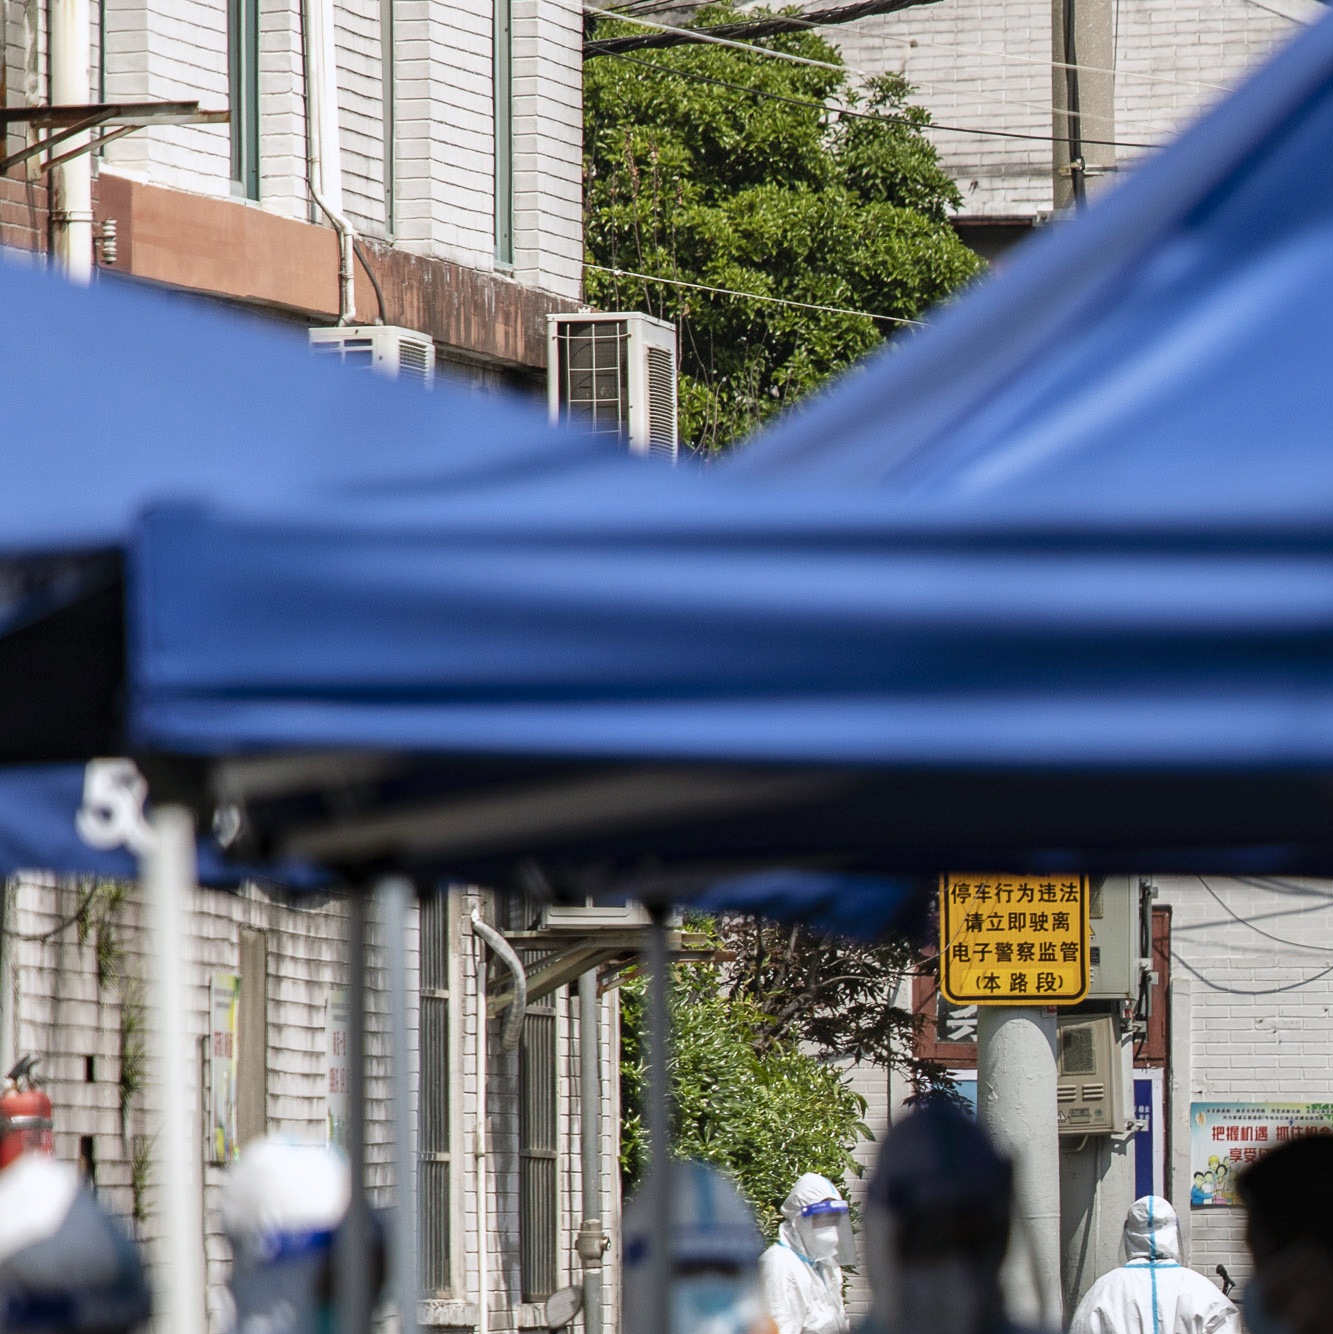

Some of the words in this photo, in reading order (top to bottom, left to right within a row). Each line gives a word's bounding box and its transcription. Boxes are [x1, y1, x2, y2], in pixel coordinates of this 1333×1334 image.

[951, 882, 1079, 904] 停车行为违法
[964, 911, 1071, 932] 请立即驶离
[952, 941, 1079, 962] 电子警察监管
[976, 972, 1063, 993] (本路段)
[1212, 1125, 1268, 1141] 把握机遇
